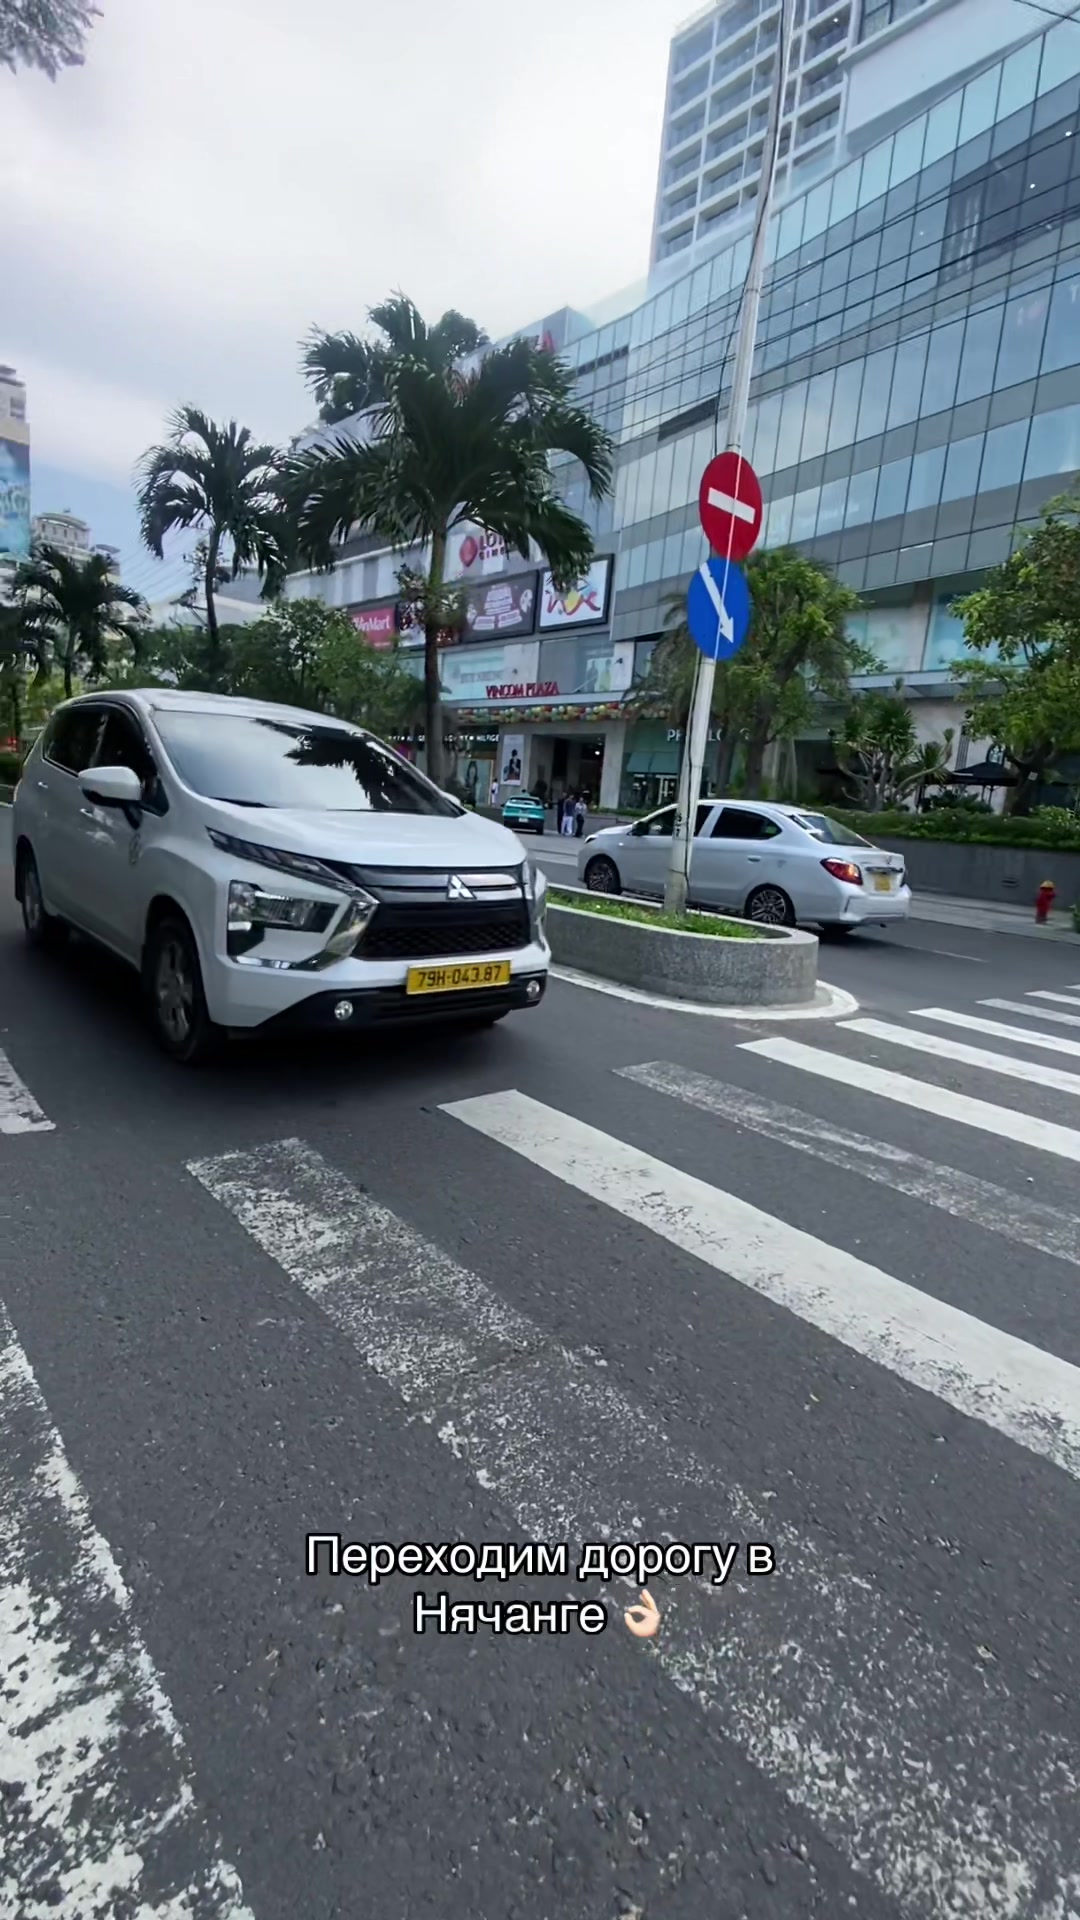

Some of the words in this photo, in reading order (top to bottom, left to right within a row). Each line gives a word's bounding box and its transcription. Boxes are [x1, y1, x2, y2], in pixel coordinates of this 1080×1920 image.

[486, 683, 525, 699] VINCOM
[526, 681, 560, 697] PLAZA
[417, 965, 502, 988] 79H-043.87
